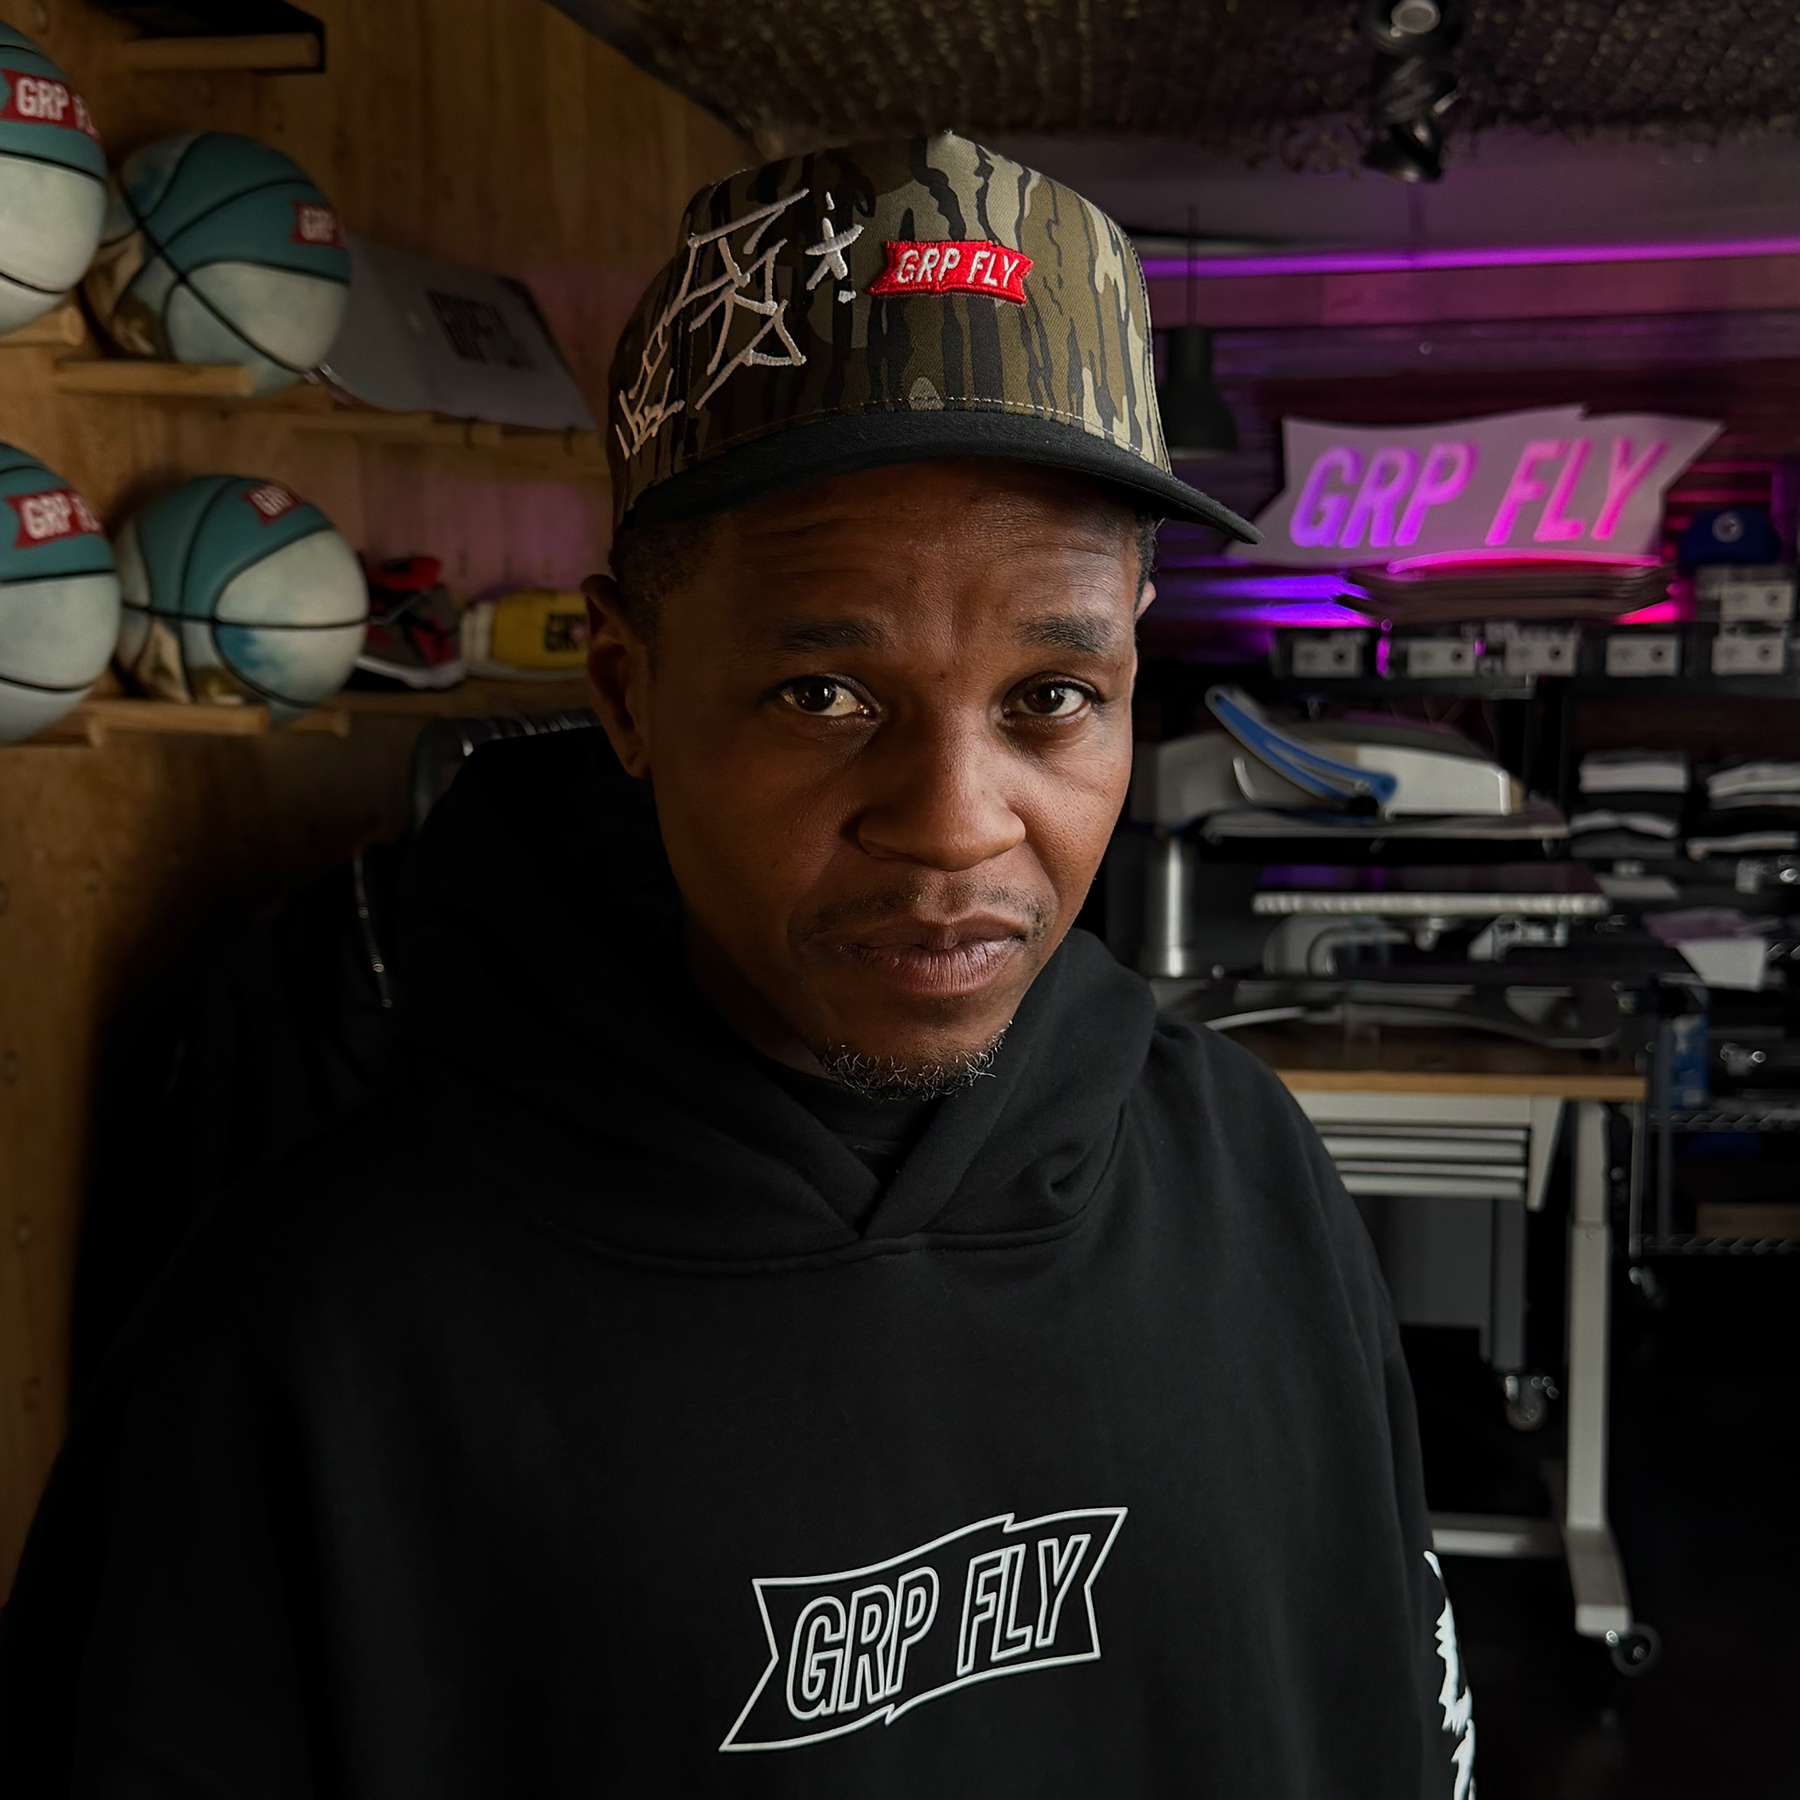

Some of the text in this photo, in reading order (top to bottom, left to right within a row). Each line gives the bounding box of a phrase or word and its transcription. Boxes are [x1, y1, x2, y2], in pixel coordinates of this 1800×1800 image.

[16, 76, 70, 121] GRP
[896, 248, 1020, 288] GRP FLY
[22, 492, 71, 539] GRP
[1289, 436, 1669, 549] GRP FLY
[786, 1533, 1092, 1720] GRP FLY
